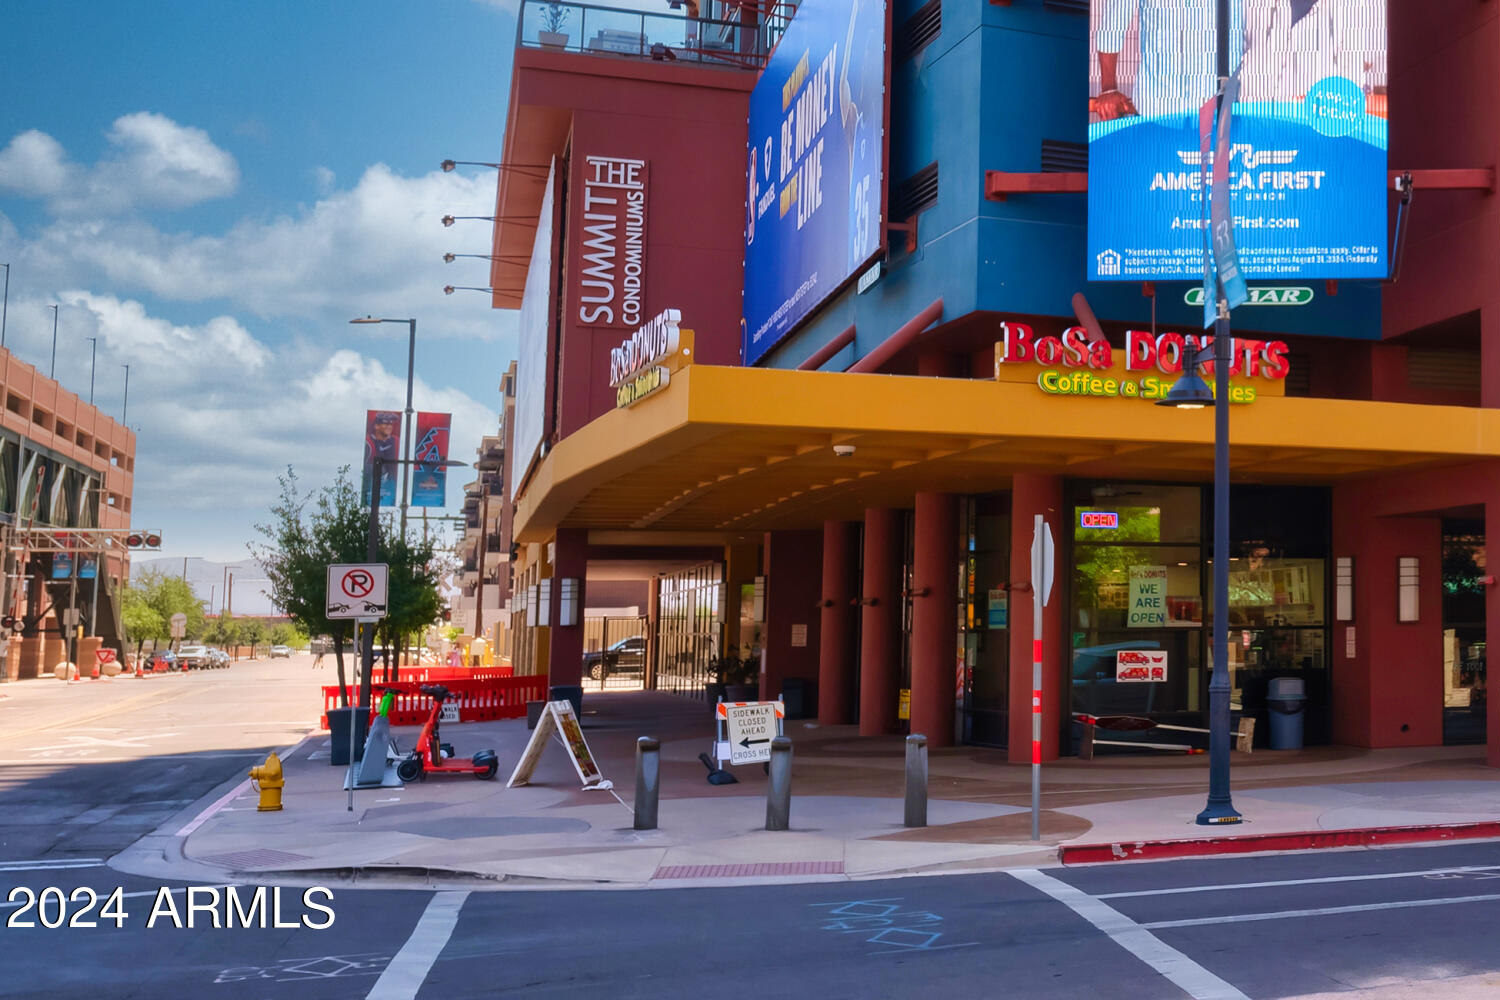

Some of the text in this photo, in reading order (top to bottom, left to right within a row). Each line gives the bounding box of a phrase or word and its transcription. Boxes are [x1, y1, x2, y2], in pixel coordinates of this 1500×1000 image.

[795, 41, 837, 163] MONEY
[589, 160, 642, 186] THE
[797, 136, 824, 231] LINE
[1149, 170, 1327, 191] AMECA FIRST
[1170, 215, 1300, 230] AmerFirst.com
[579, 187, 618, 324] SUMMIT
[622, 190, 645, 325] CONDOMINIUMS
[1195, 290, 1300, 303] LAR
[999, 320, 1115, 370] BoSa
[1041, 370, 1256, 403] Coffee & Smies
[1083, 514, 1116, 527] OPEN
[1139, 583, 1159, 594] WE
[1135, 597, 1161, 608] ARE
[1130, 612, 1165, 623] OPEN
[732, 708, 770, 718] SIDEWALK
[738, 717, 767, 727] CLOSED
[741, 726, 766, 736] AHEAD
[733, 747, 771, 760] CROSS HE
